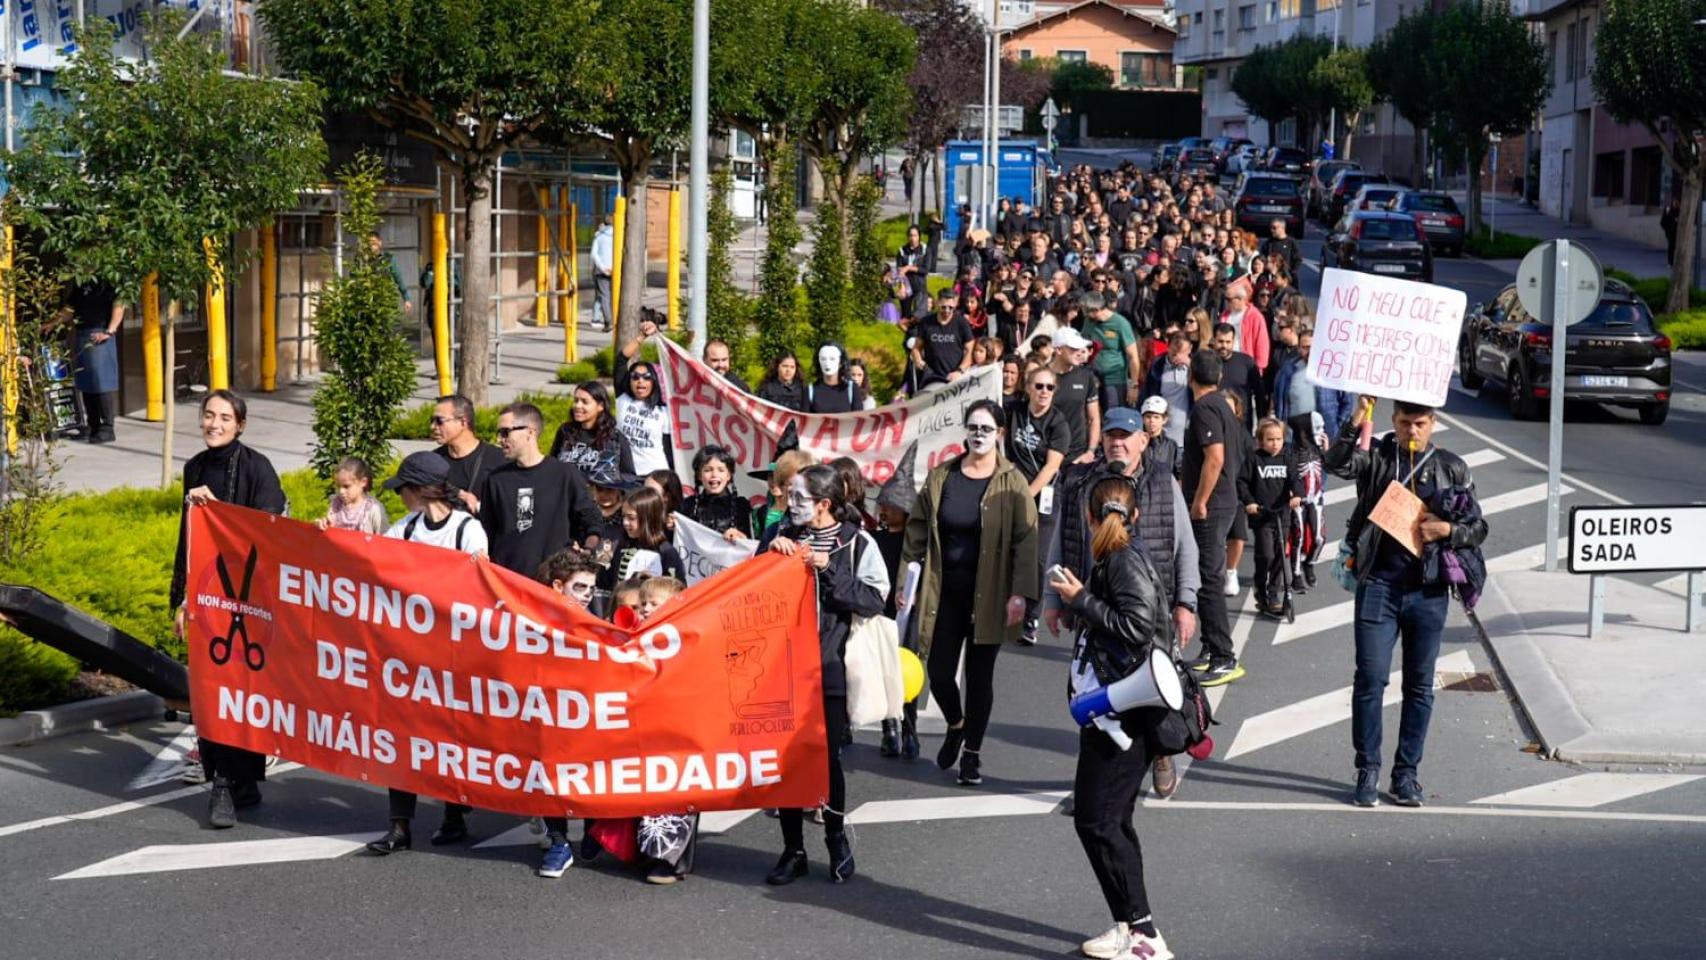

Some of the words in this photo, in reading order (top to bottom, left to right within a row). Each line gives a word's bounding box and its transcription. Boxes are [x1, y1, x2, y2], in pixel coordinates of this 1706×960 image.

[1332, 285, 1360, 311] NO
[1368, 291, 1405, 317] MEU
[1410, 296, 1446, 324] COLE
[1328, 318, 1352, 342] OS
[1317, 349, 1345, 379] AS
[810, 416, 840, 452] A
[851, 407, 909, 453] UN
[1257, 465, 1288, 479] VANS
[1581, 516, 1673, 536] OLEIROS
[1581, 543, 1637, 561] SADA
[197, 594, 220, 608] NON
[221, 601, 238, 612] aos
[240, 604, 273, 621] recortes
[278, 563, 435, 634] ENSINO
[316, 640, 368, 688] DE
[382, 658, 629, 730] CALIDADE
[218, 686, 295, 737] NON
[306, 709, 397, 764] MÁIS
[410, 736, 782, 796] PRECARIEDADE
